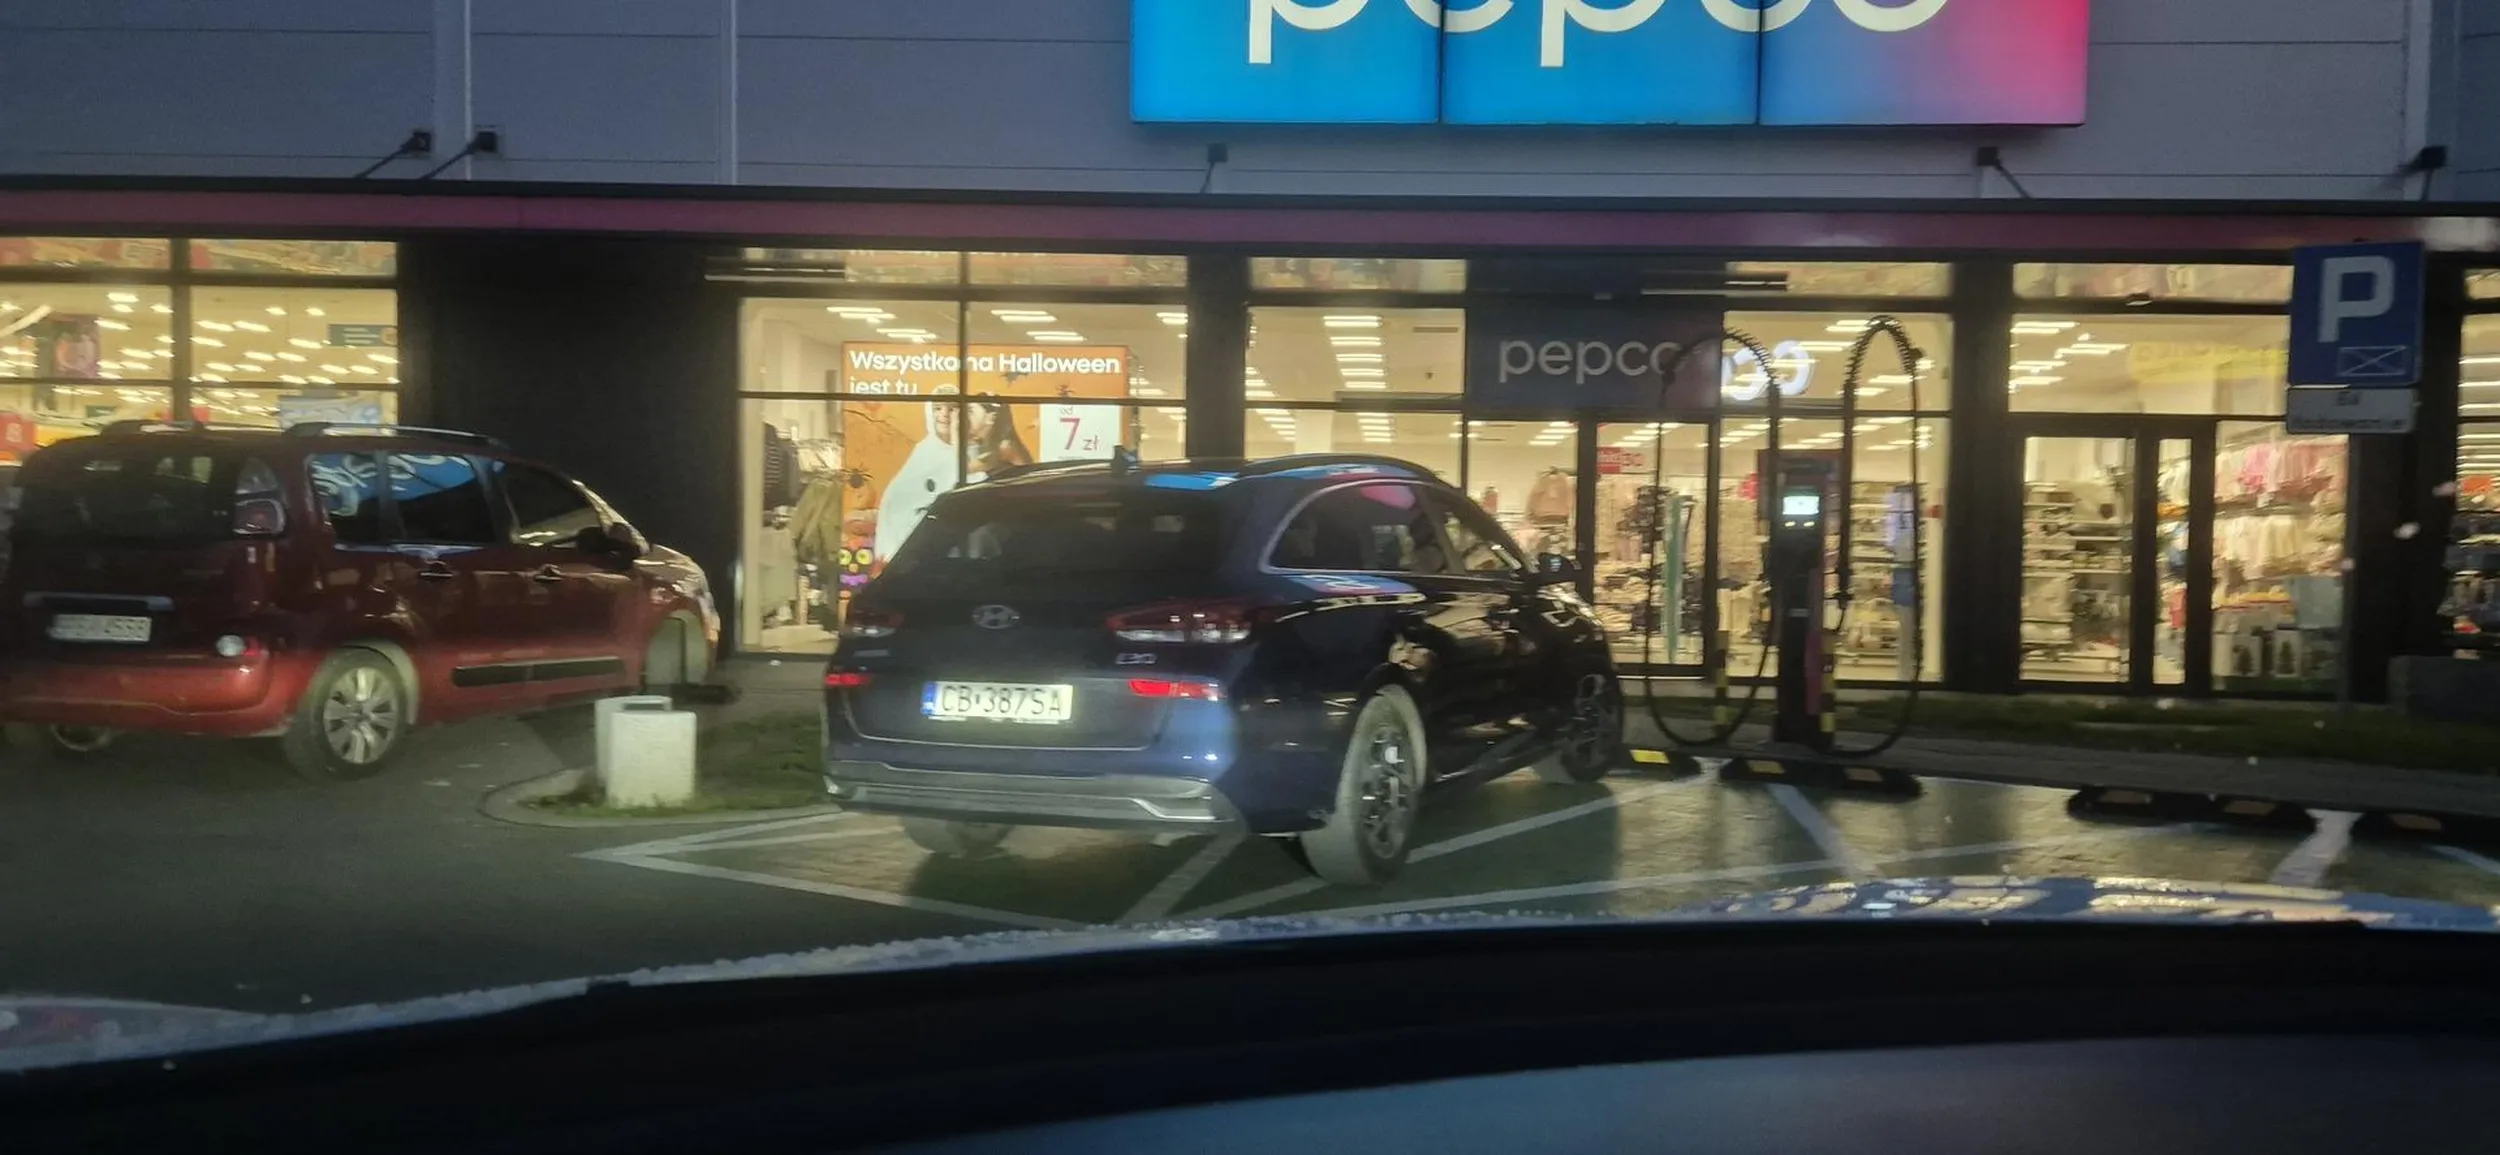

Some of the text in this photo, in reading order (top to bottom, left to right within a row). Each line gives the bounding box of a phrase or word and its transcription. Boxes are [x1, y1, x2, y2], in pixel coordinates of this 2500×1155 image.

[2318, 256, 2395, 342] P
[850, 350, 960, 374] Wszystko
[1000, 353, 1120, 374] Halloween
[1059, 417, 1080, 450] 7
